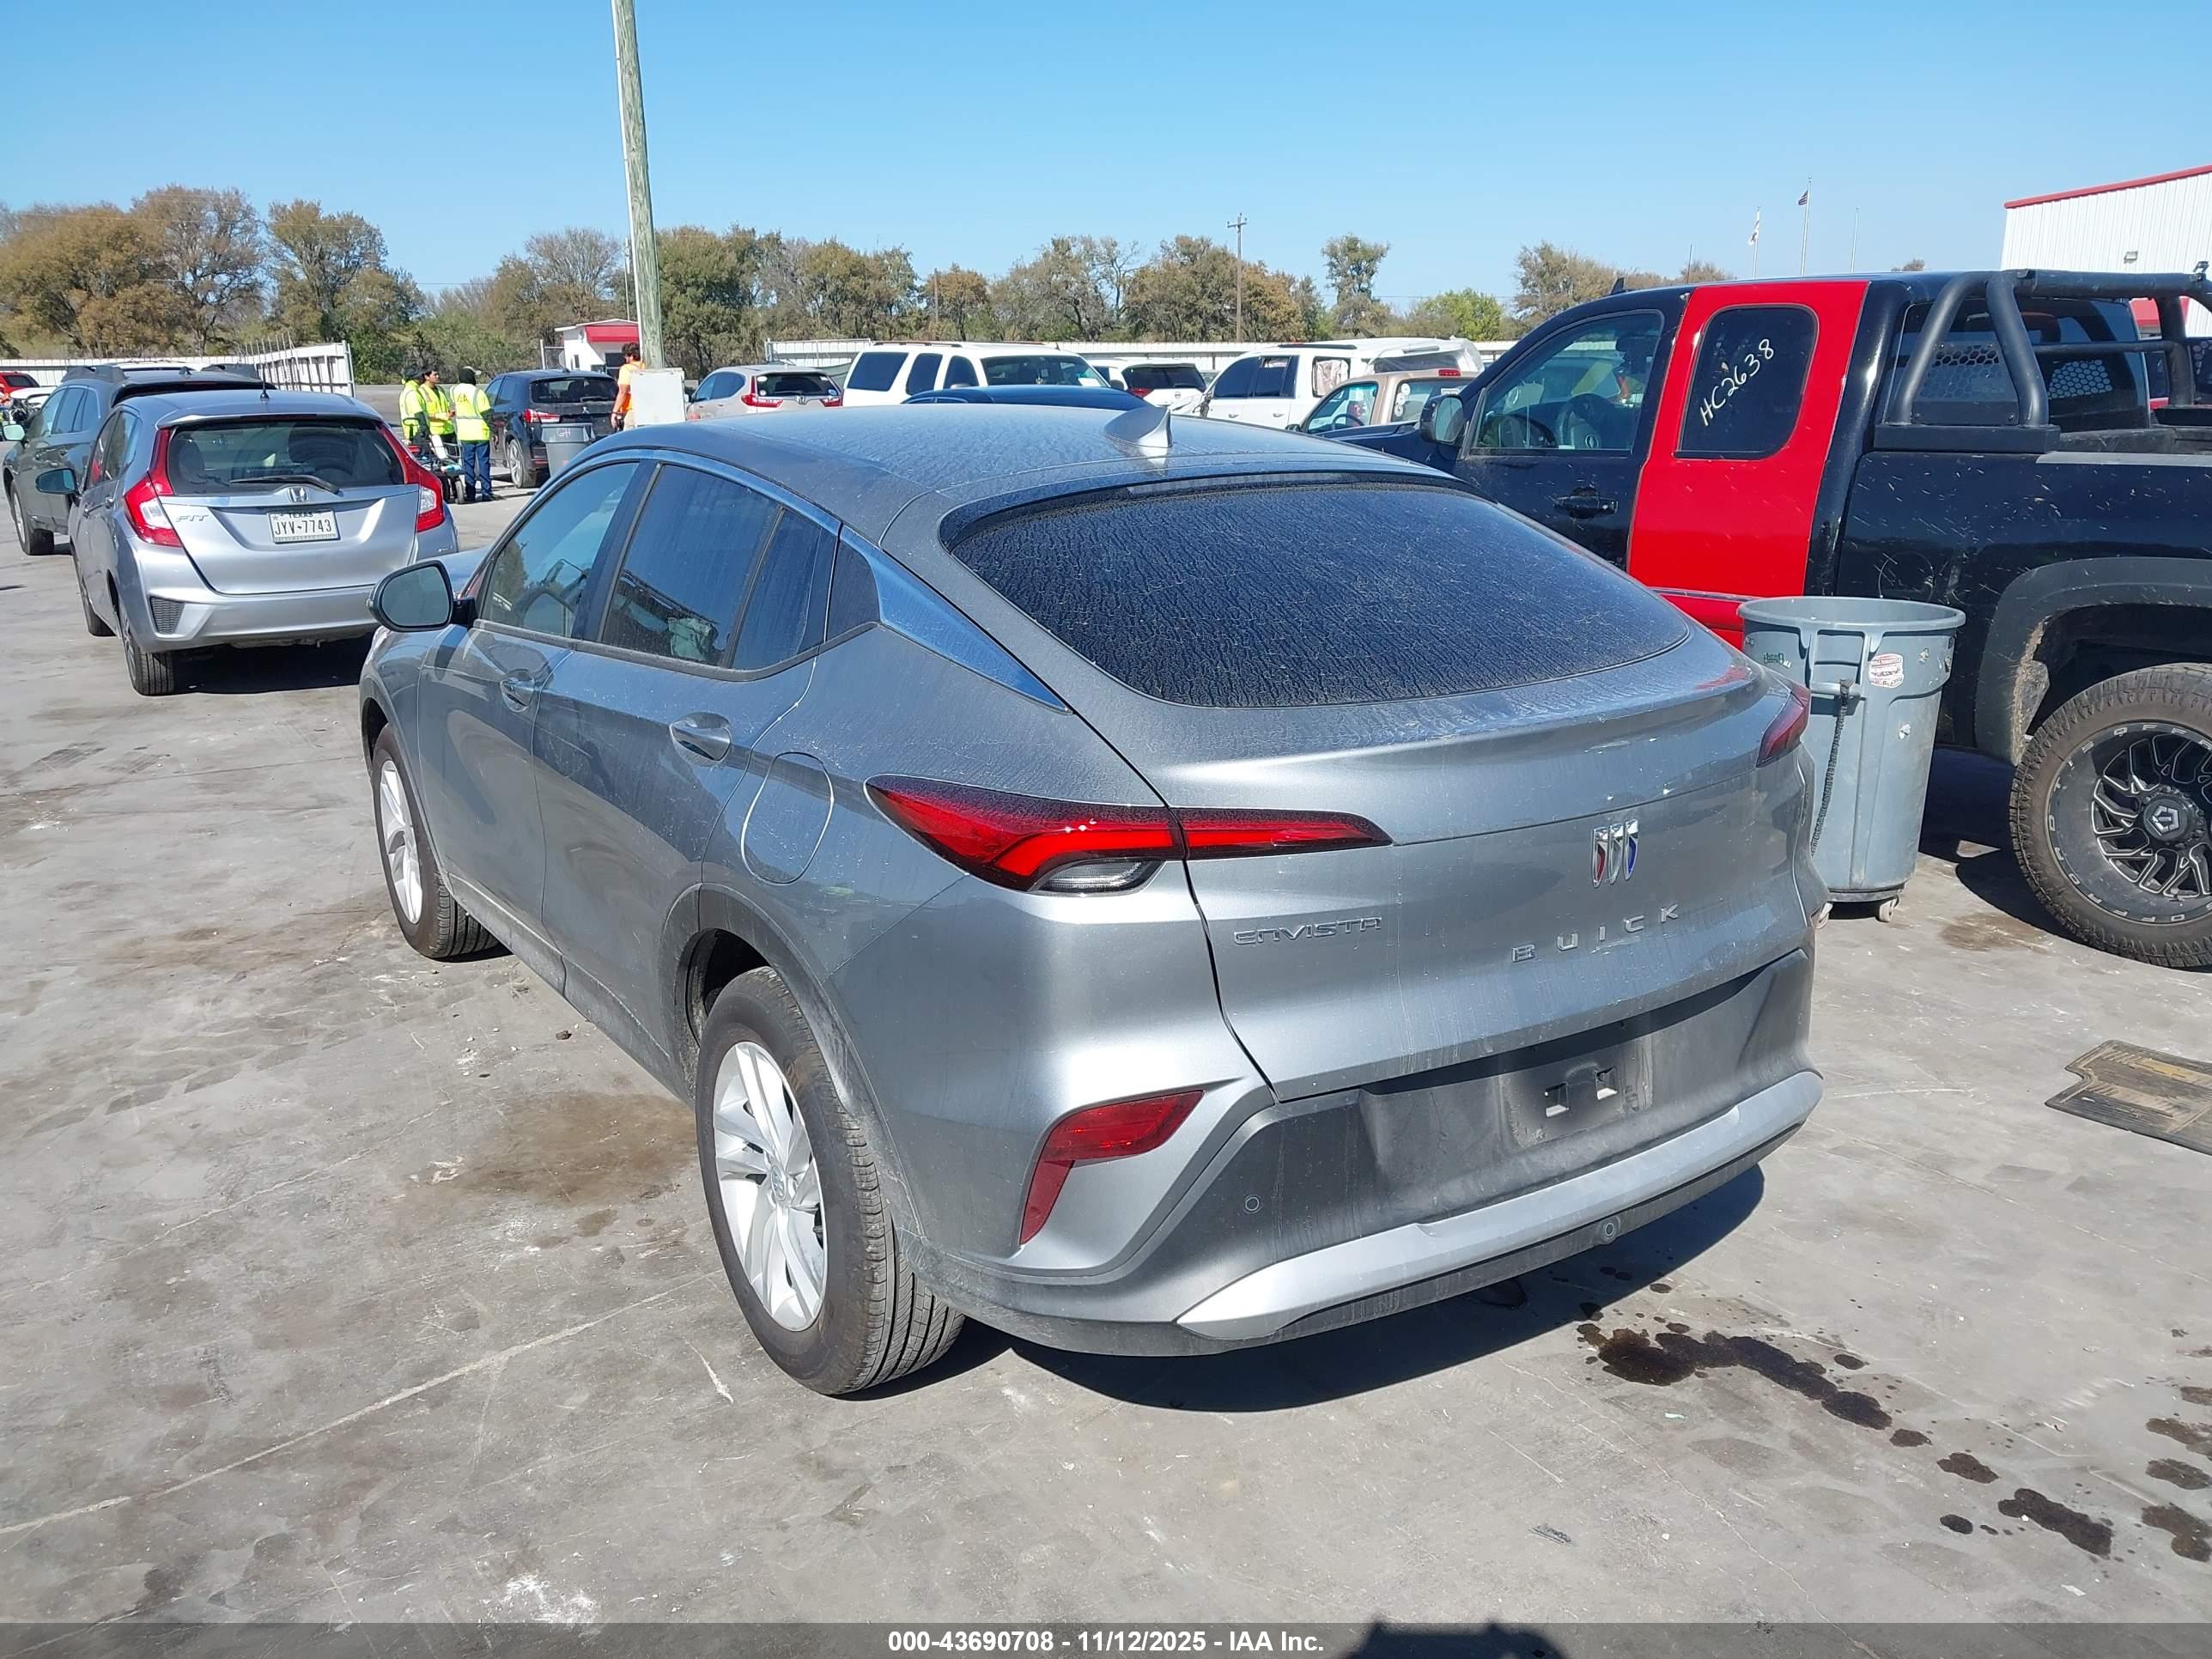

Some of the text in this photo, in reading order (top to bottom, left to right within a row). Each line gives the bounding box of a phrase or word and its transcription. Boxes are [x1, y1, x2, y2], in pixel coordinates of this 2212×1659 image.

[1699, 338, 1775, 426] HC2638
[274, 519, 332, 536] JYV-7743
[1233, 916, 1382, 945] ENVISTA
[1510, 903, 1680, 962] BUICK
